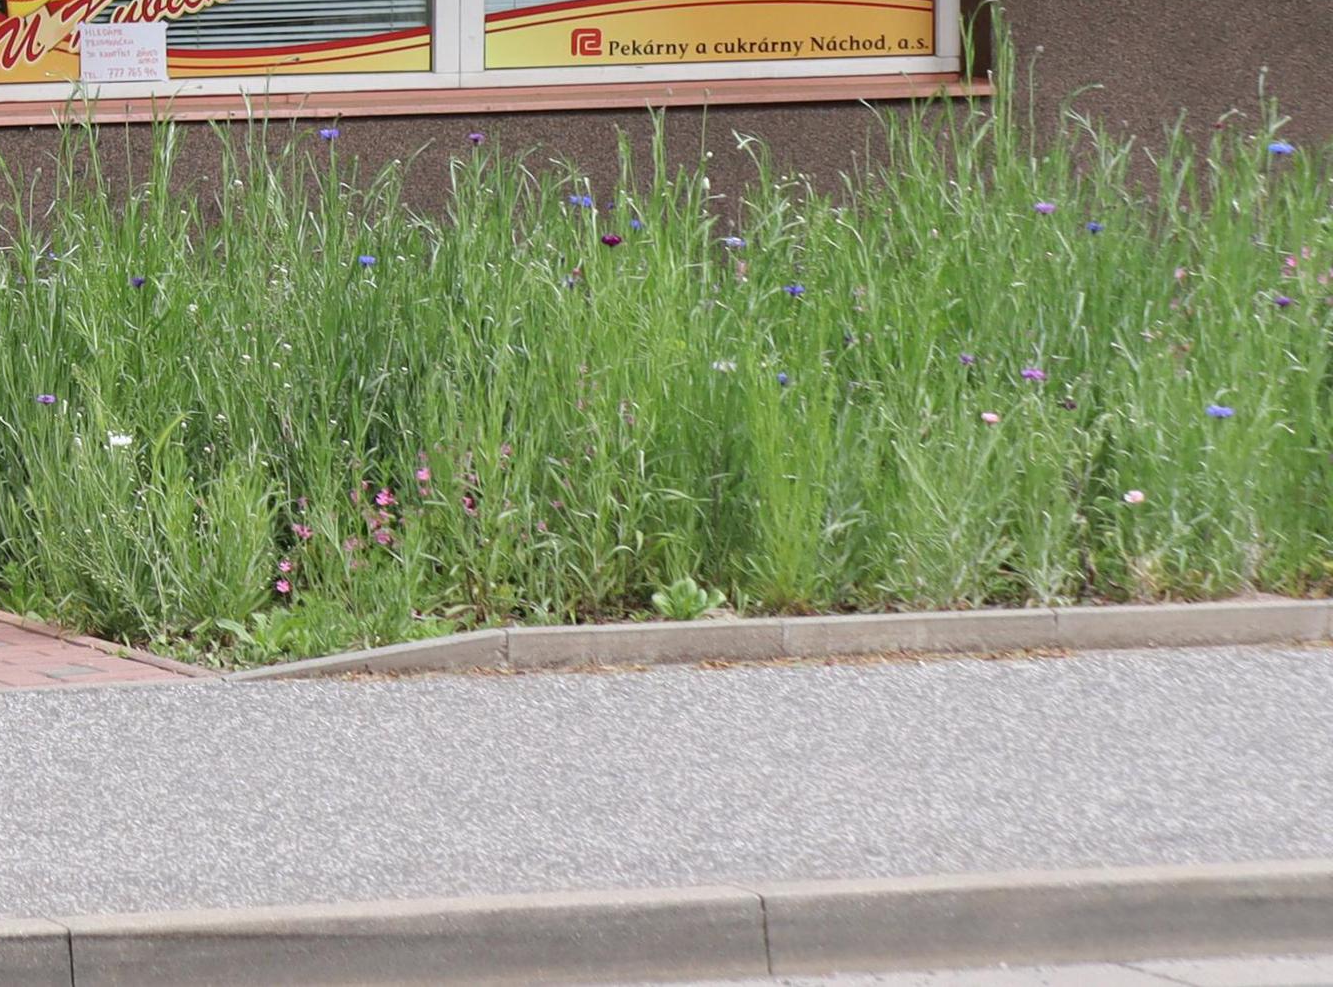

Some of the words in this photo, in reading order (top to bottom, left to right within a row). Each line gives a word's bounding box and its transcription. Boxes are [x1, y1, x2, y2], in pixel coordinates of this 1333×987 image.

[608, 39, 688, 60] Pekárny
[696, 42, 707, 55] a
[713, 37, 804, 58] cukrárny
[811, 34, 893, 53] Náchod,
[897, 37, 930, 51] a.s.
